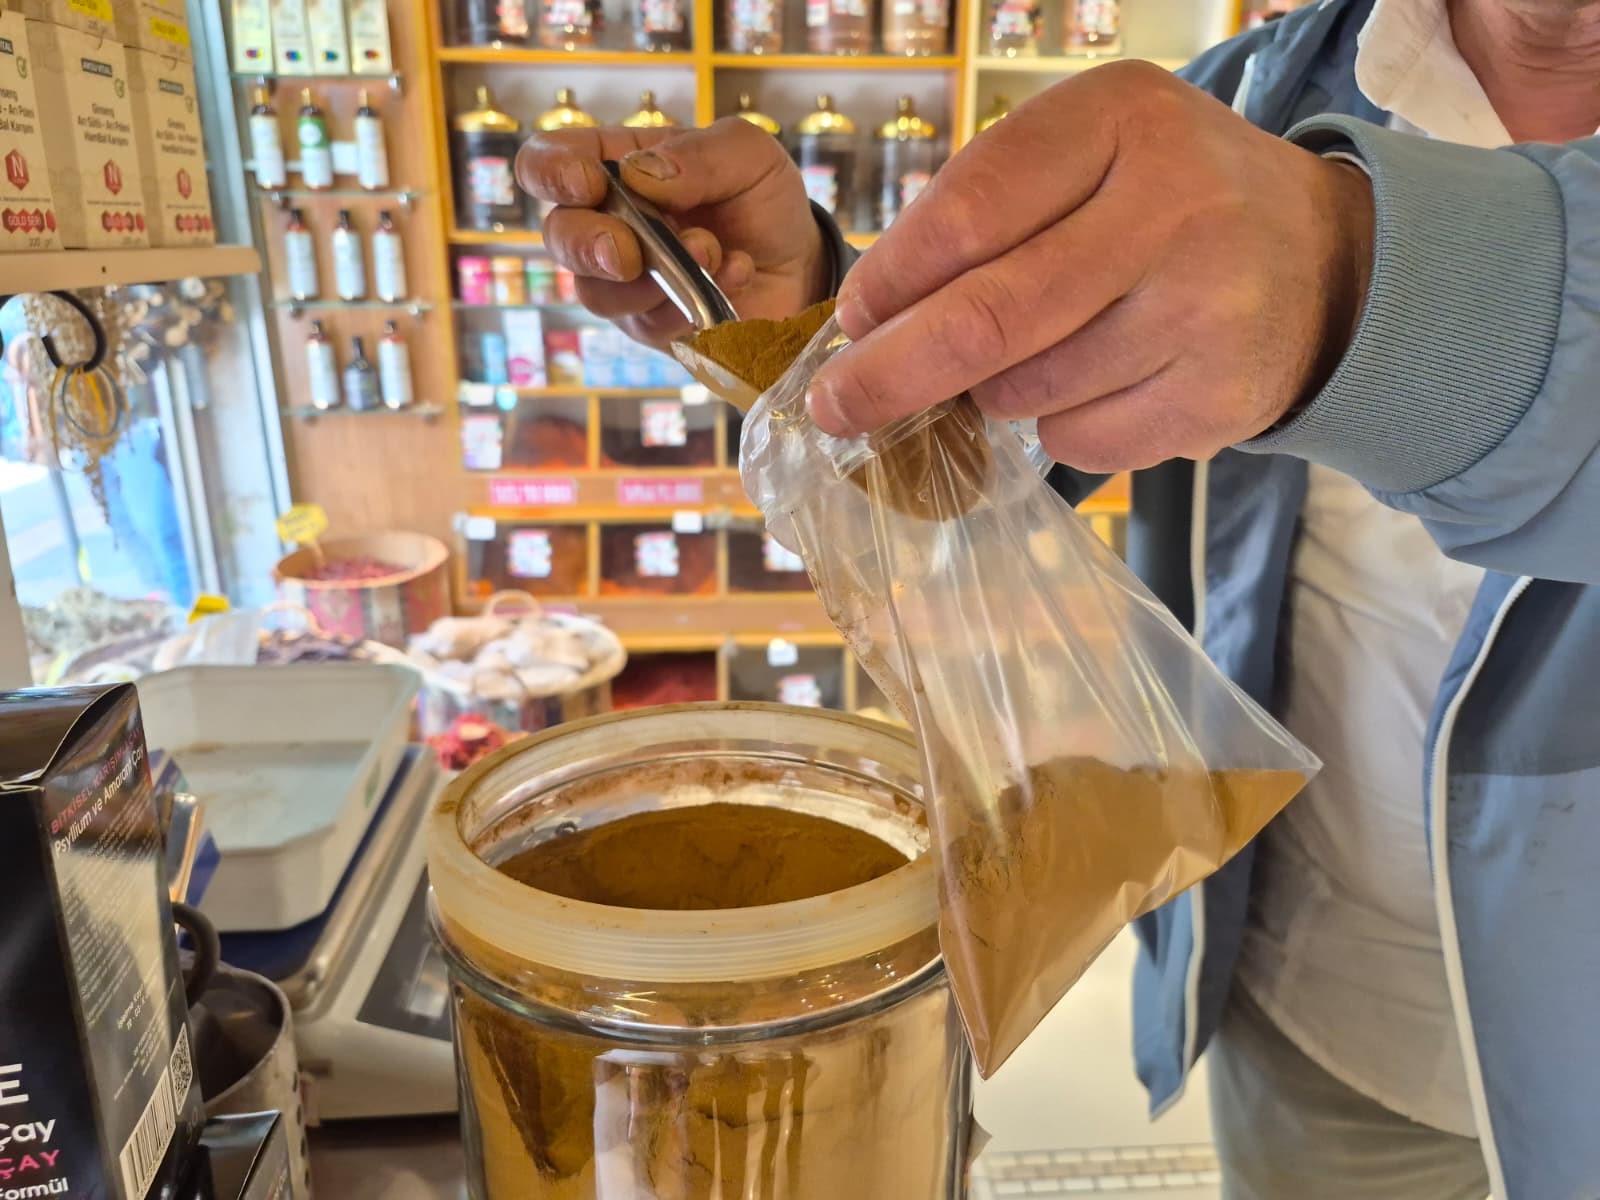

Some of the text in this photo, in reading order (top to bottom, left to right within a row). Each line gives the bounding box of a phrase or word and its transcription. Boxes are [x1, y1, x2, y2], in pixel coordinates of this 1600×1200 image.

[12, 154, 24, 177] N
[54, 810, 92, 857] Psyllium
[91, 797, 103, 816] ve
[0, 1177, 69, 1200] ormül
